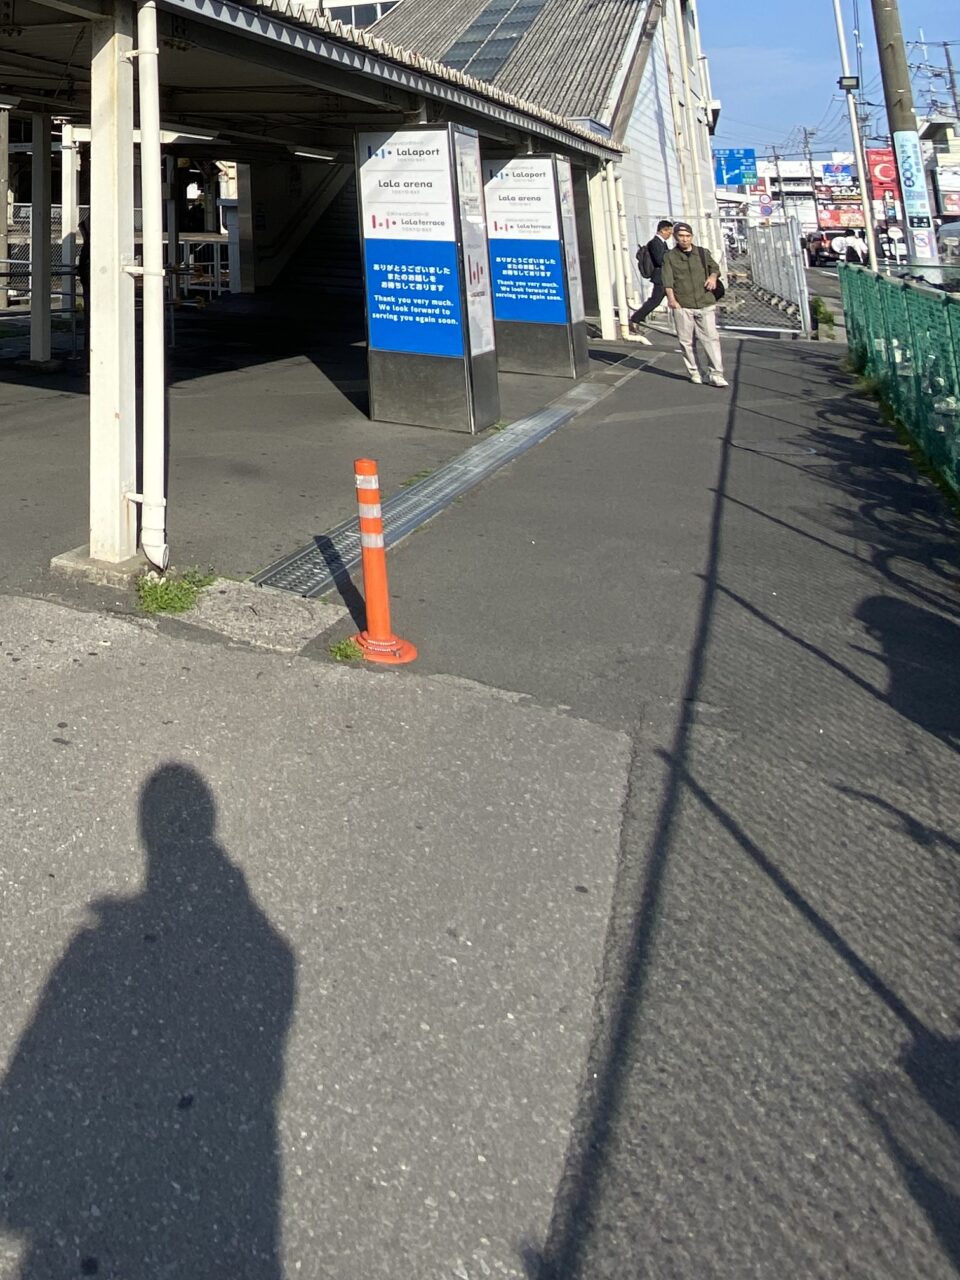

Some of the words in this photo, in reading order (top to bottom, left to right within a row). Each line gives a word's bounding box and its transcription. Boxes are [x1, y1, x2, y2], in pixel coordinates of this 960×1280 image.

[396, 148, 440, 157] LaLaport
[378, 180, 400, 188] LaLa
[495, 257, 556, 265] ありがとうございました
[373, 263, 451, 274] ありがとうございました
[381, 281, 445, 292] お待ちしております
[374, 294, 396, 303] Thank
[413, 298, 429, 306] very
[392, 304, 409, 312] look
[410, 306, 440, 315] forward
[372, 313, 398, 322] serving
[415, 316, 436, 324] again
